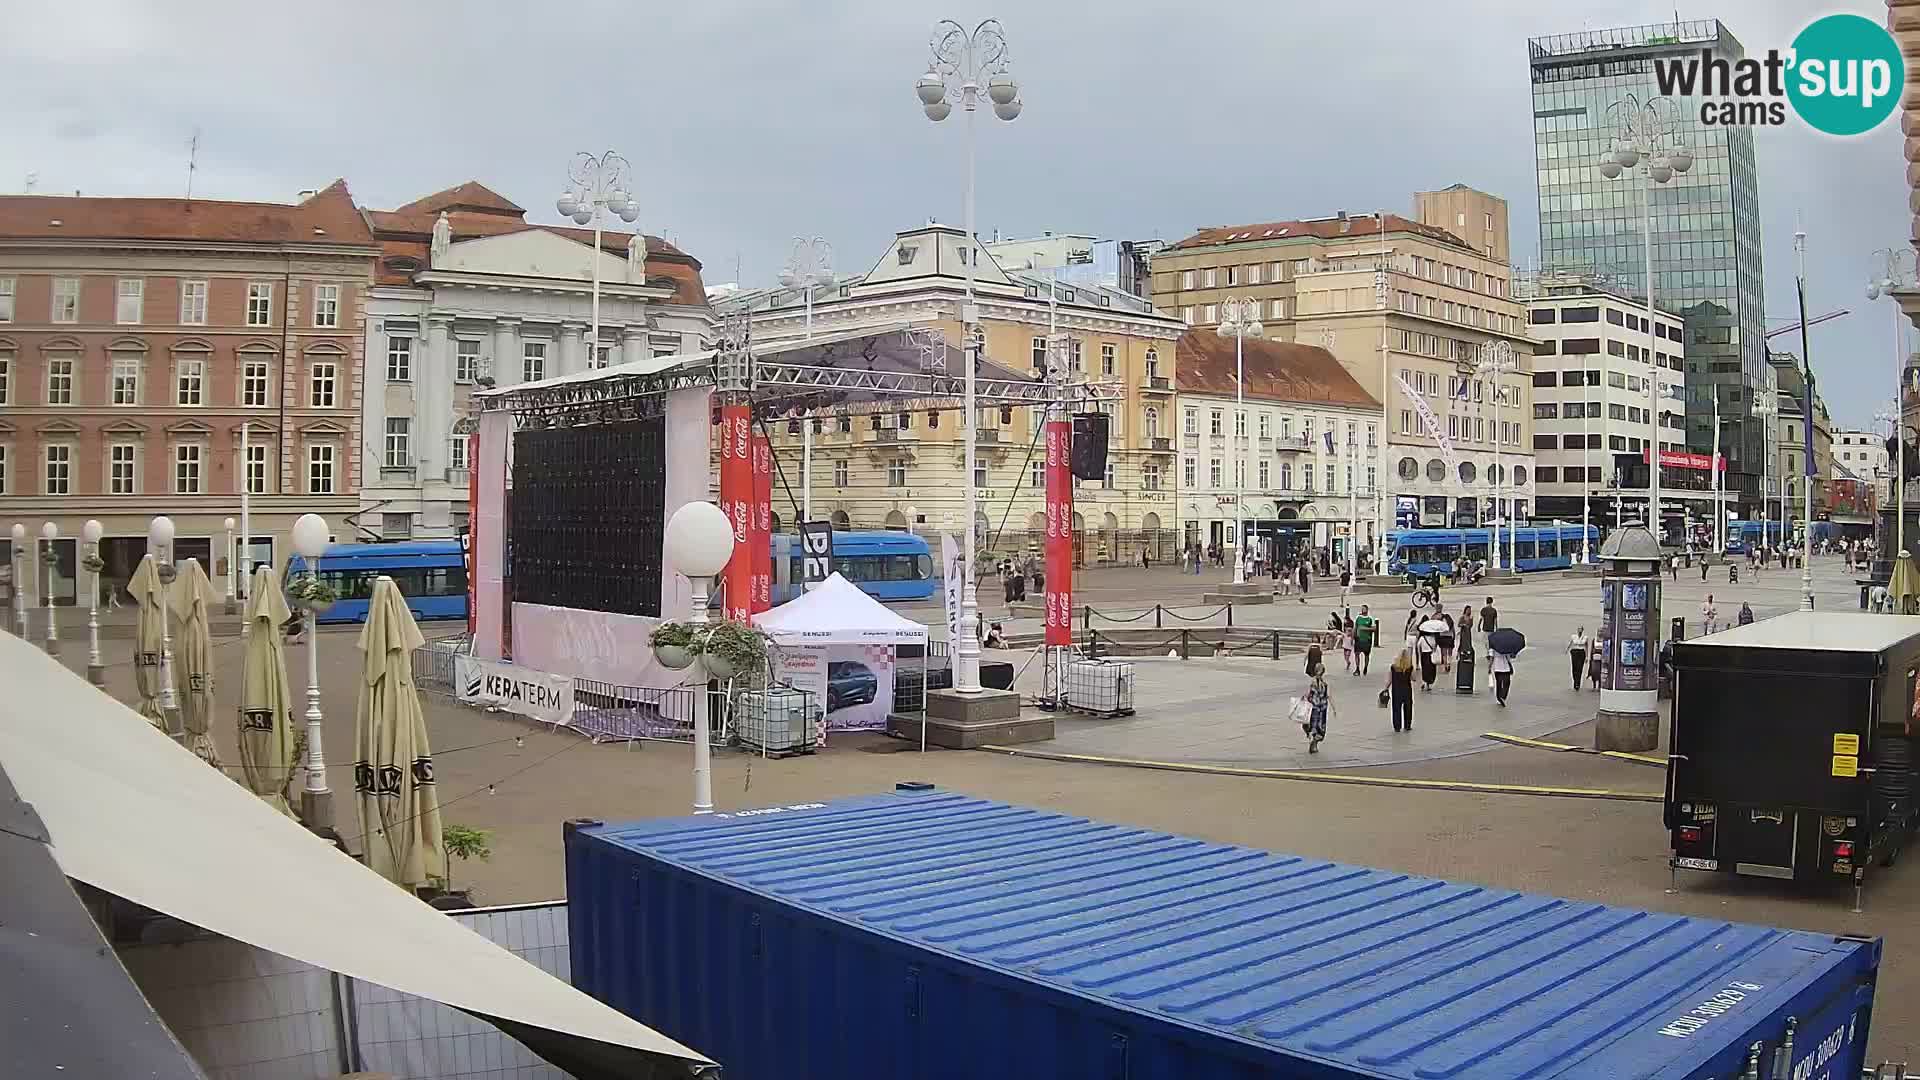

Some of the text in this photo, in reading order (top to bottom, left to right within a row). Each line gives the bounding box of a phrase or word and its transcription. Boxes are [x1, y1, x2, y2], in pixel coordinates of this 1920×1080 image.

[735, 415, 748, 458] Coca-Cola
[734, 500, 747, 543] Coca-Cola
[486, 674, 561, 711] KERATERM
[1657, 1014, 1709, 1038] MCDU
[1690, 989, 1748, 1017] 300629
